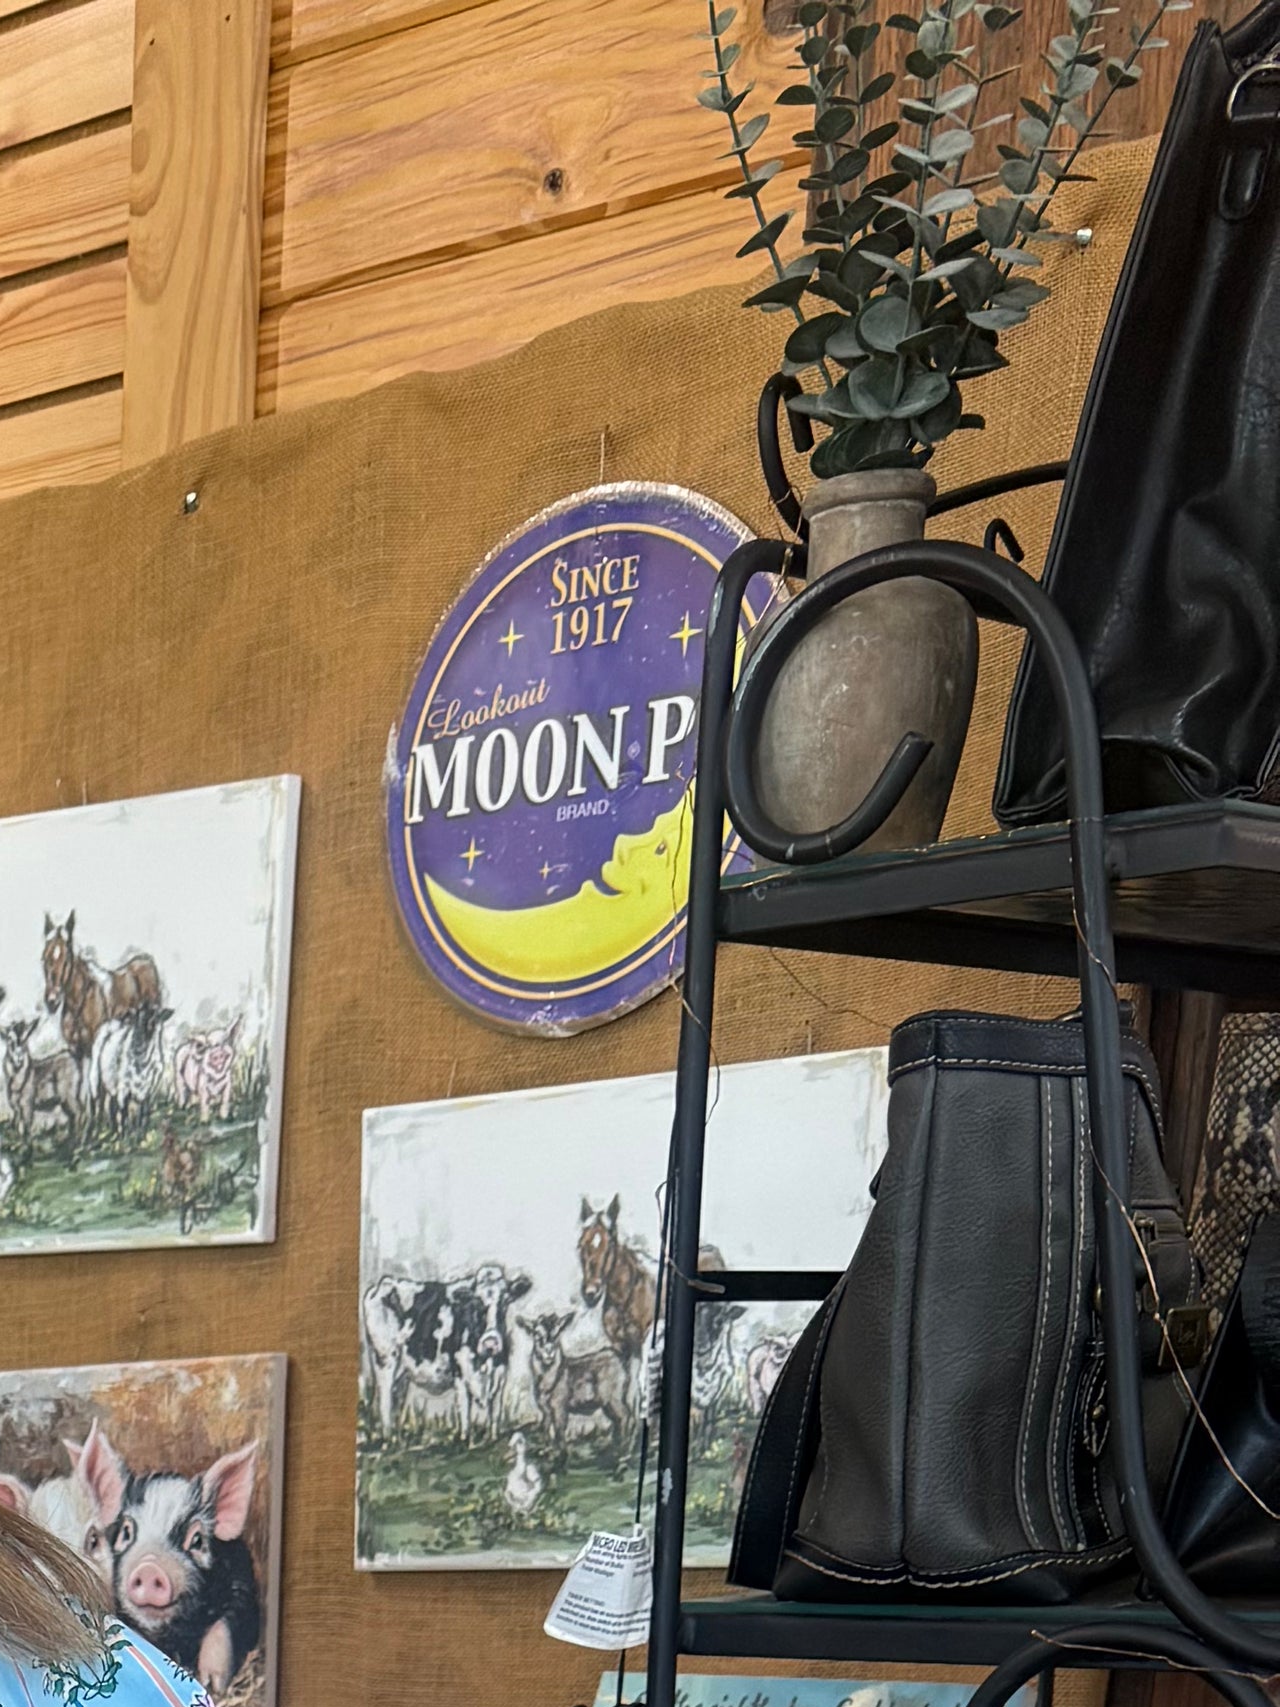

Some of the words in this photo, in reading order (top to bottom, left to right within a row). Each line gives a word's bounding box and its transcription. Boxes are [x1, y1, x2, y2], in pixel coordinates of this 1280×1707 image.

[550, 554, 640, 608] SINCE
[550, 597, 633, 654] 1917
[427, 678, 551, 740] Lookout
[406, 705, 630, 825] MOON
[556, 799, 610, 822] BRAND
